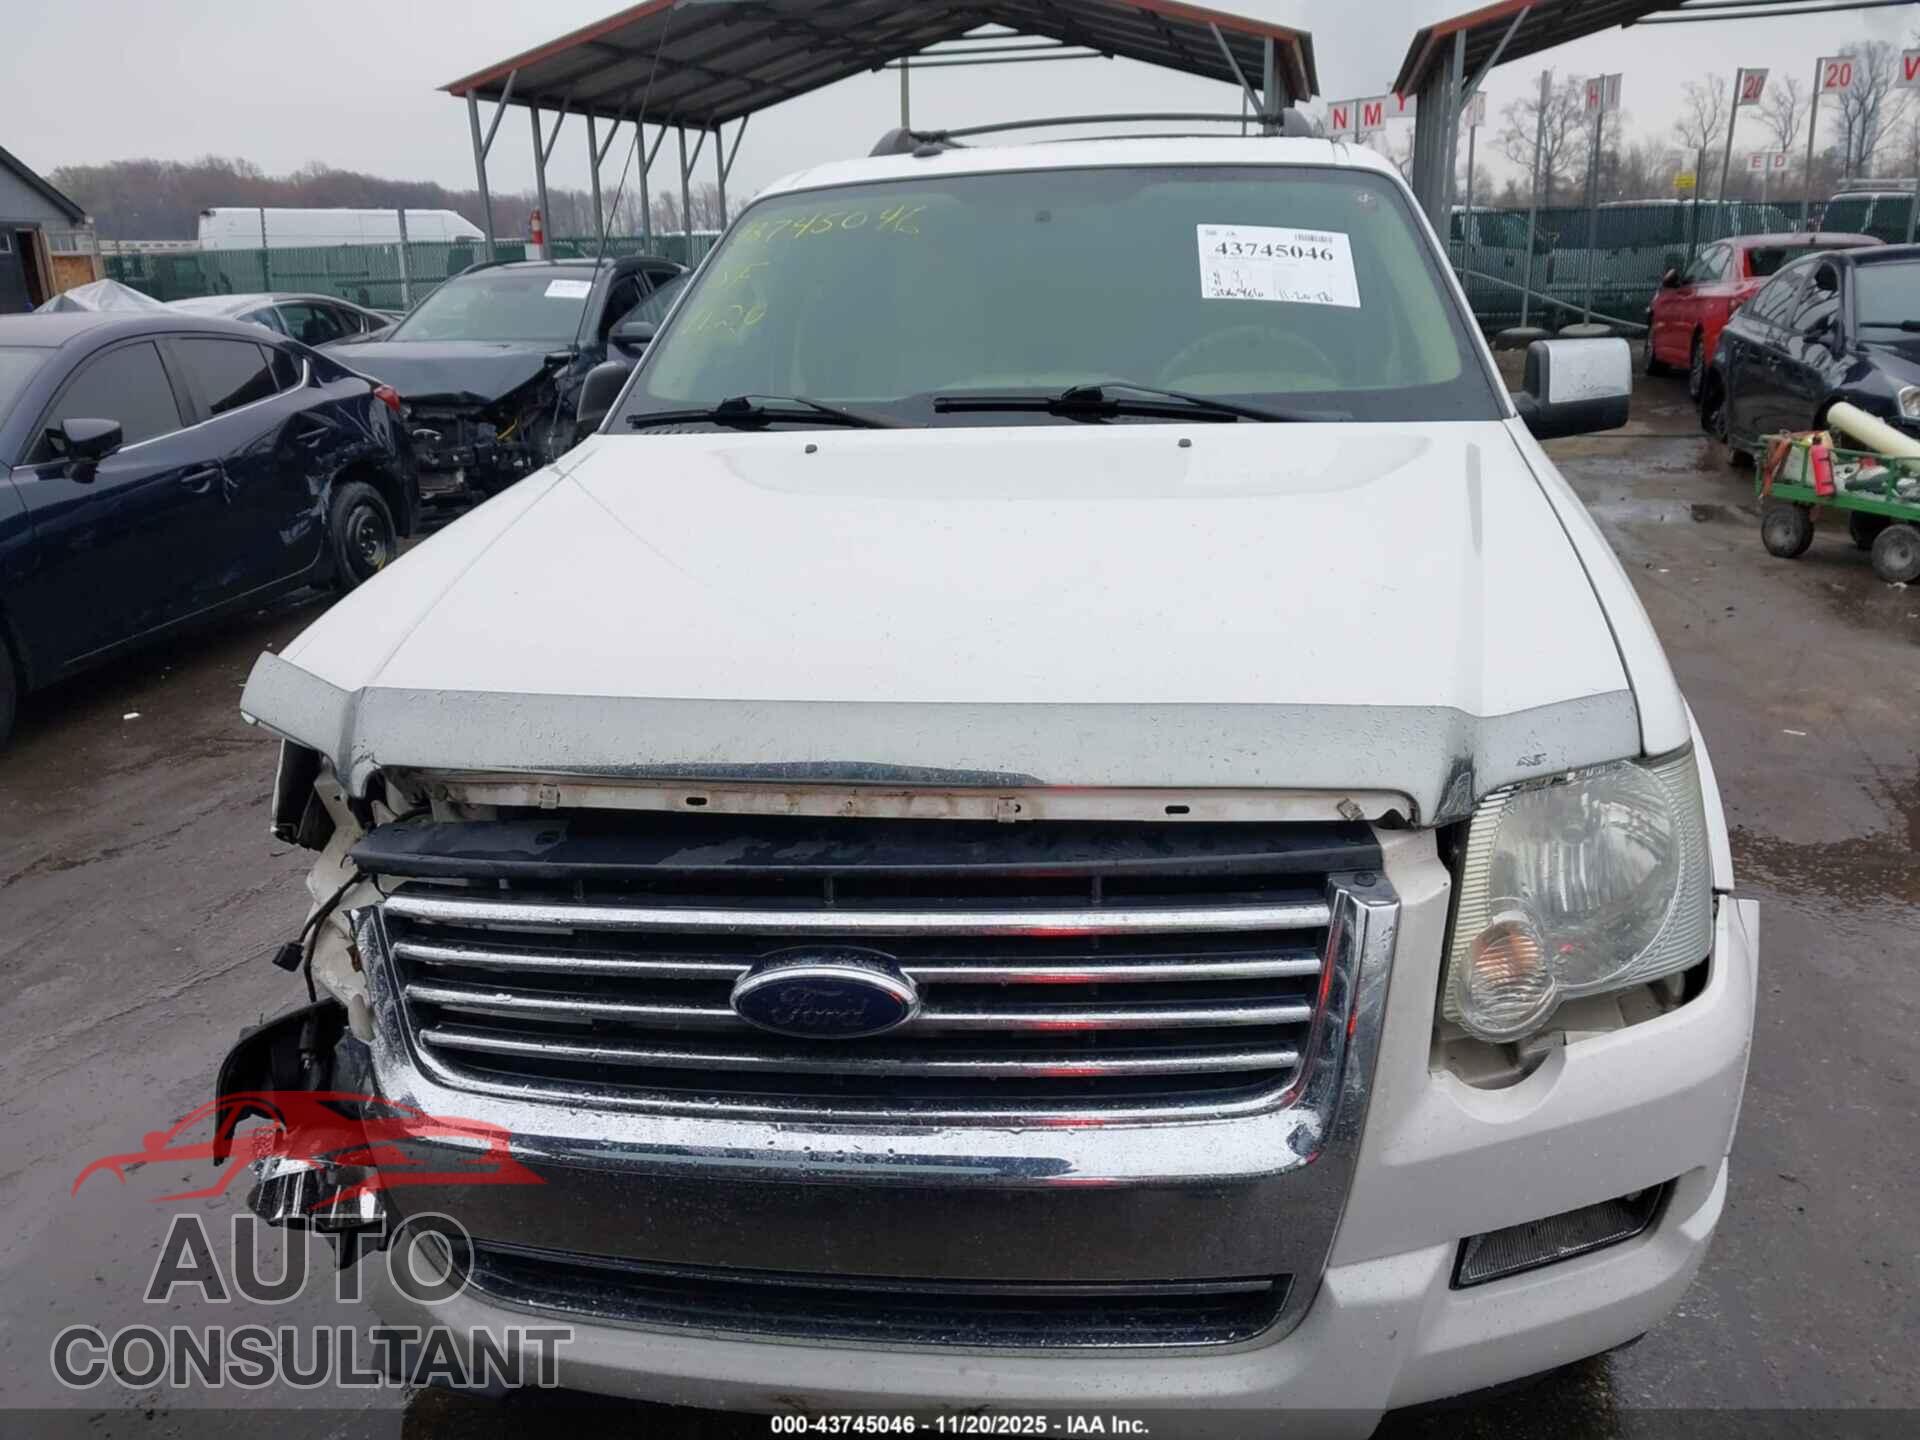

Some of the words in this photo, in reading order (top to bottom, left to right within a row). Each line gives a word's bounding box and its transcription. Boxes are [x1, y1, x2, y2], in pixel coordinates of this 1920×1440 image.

[1825, 63, 1851, 88] 20
[1332, 107, 1348, 129] N
[1363, 102, 1382, 127] M
[1214, 241, 1334, 262] 43745046
